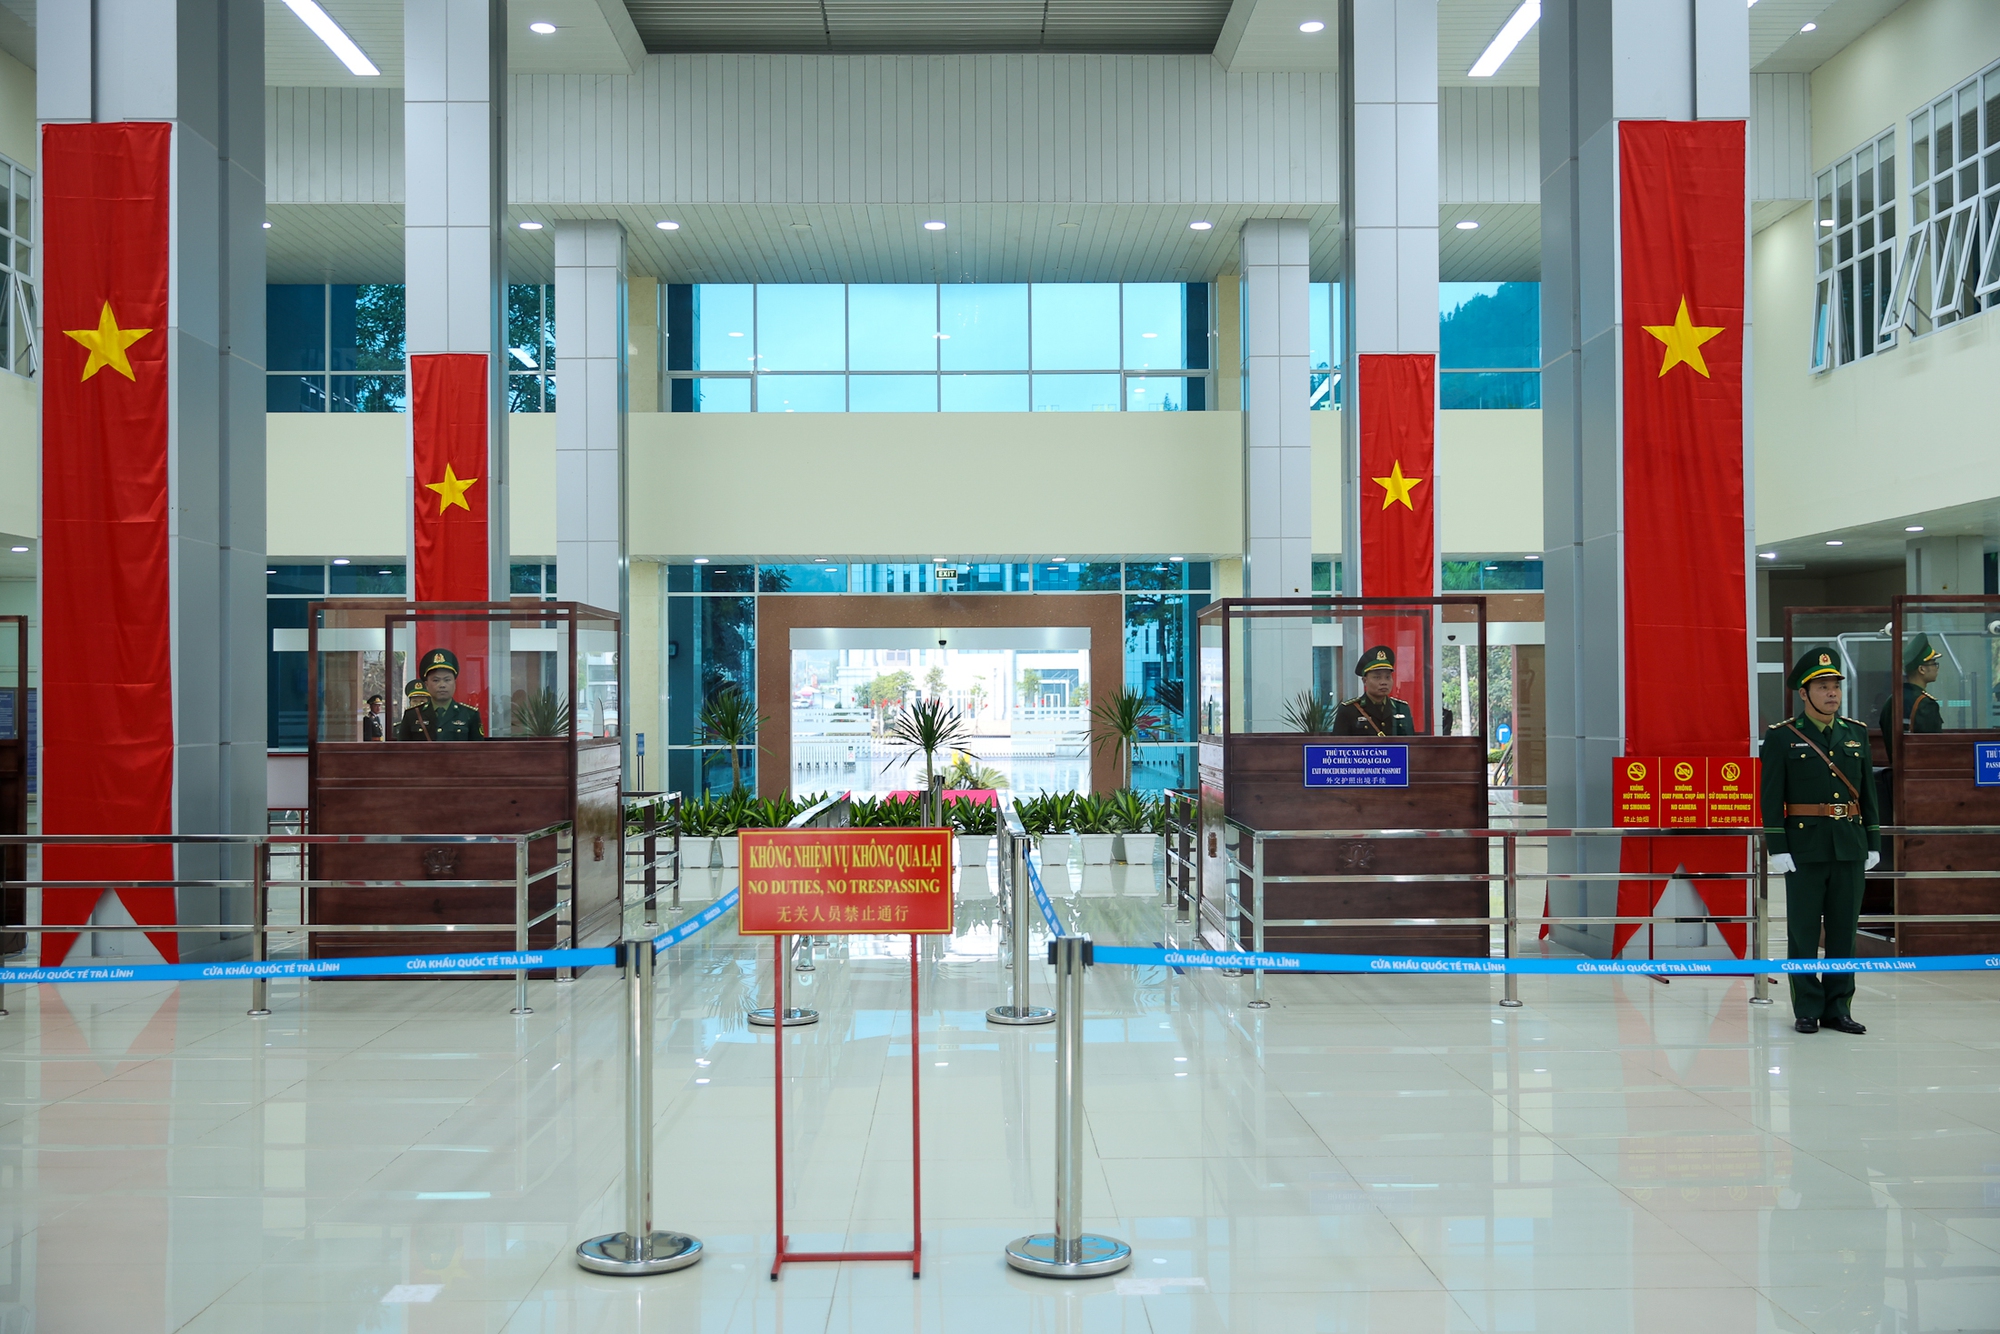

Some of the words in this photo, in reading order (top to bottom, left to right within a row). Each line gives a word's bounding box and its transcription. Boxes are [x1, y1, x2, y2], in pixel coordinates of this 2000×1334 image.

[1322, 756, 1332, 765] HỘ
[749, 838, 792, 868] KHÔNG
[794, 842, 832, 874] NHIỆM
[834, 845, 850, 873] VỤ
[852, 838, 893, 868] KHÔNG
[896, 844, 920, 872] QUA
[922, 844, 942, 873] LẠI
[748, 880, 768, 894] NO
[771, 880, 824, 896] DUTIES,
[827, 879, 847, 894] NO
[849, 879, 940, 894] TRESPASSING
[777, 905, 909, 923] 无关人员禁止通行
[407, 959, 426, 969] CỬA
[429, 957, 456, 968] KHẨU
[458, 957, 486, 968] QUỐC
[487, 956, 499, 965] TẾ
[500, 955, 518, 965] TRÀ
[520, 954, 543, 964] LĨNH
[1165, 952, 1185, 963] CỬA
[1186, 953, 1213, 964] KHẨU
[1214, 955, 1243, 965] QUỐC
[1244, 956, 1255, 966] TẾ
[1256, 957, 1274, 966] TRÀ
[1277, 957, 1300, 967] LĨNH
[1371, 959, 1391, 969] CỬA
[1393, 960, 1419, 970] KHẨU
[1421, 961, 1449, 971] QUỐC
[1450, 961, 1461, 970] TẾ
[1462, 962, 1480, 970] TRÀ
[1483, 962, 1505, 971] LĨNH
[1781, 962, 1801, 970] CỬA
[1803, 961, 1829, 970] KHẨU
[1831, 961, 1859, 970] QUỐC
[1860, 961, 1872, 969] TẾ
[1893, 961, 1916, 969] LĨNH
[1985, 957, 2000, 966] CỬ
[203, 966, 223, 975] CỬA
[225, 965, 252, 975] KHẨU
[254, 964, 282, 974] QUỐC
[284, 963, 296, 972] TẾ
[298, 963, 315, 972] TRÀ
[317, 962, 340, 972] LĨNH
[1577, 963, 1596, 971] CỬA
[1598, 963, 1625, 972] KHẨU
[1627, 963, 1654, 972] QUỐC
[1656, 963, 1668, 972] TẾ
[18, 970, 46, 979] KHẨU
[47, 970, 76, 979] QUỐC
[77, 970, 90, 978] TẾ
[90, 970, 108, 978] TRÀ
[111, 969, 134, 978] LĨNH
